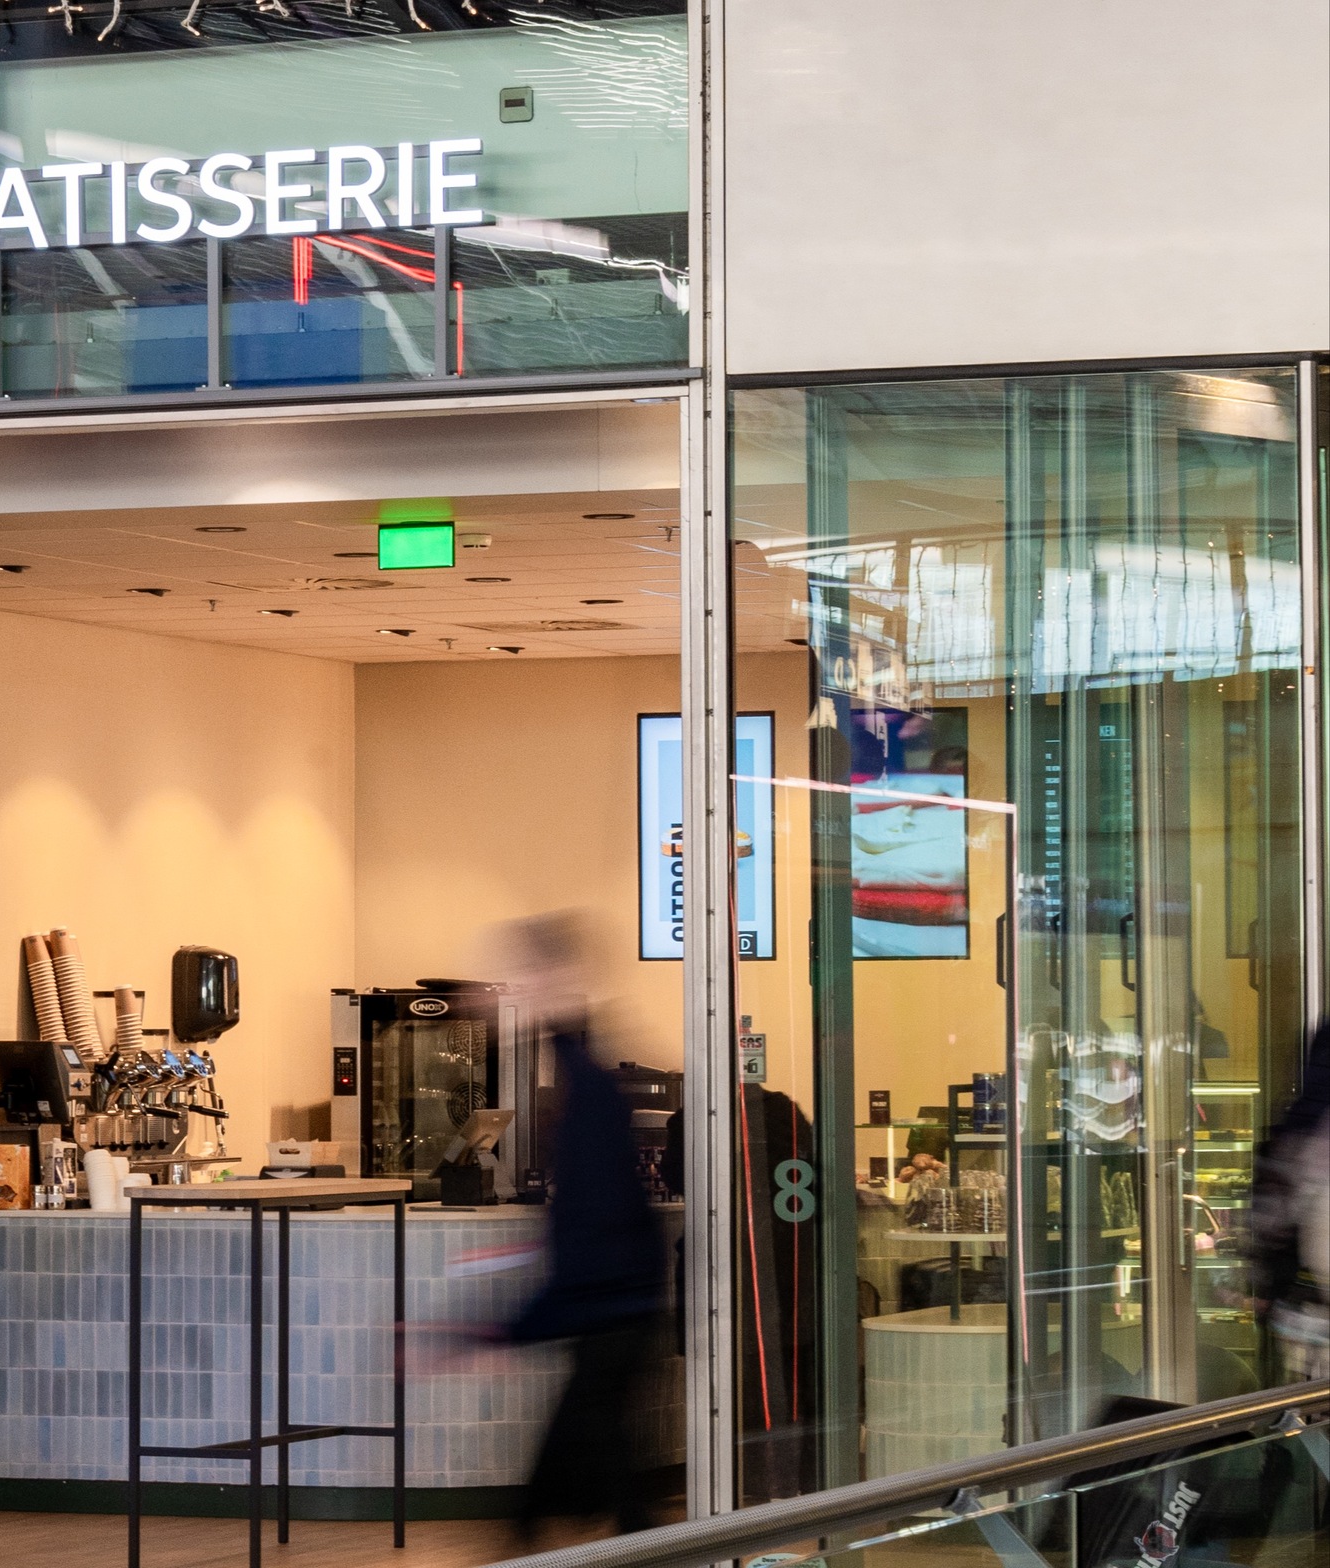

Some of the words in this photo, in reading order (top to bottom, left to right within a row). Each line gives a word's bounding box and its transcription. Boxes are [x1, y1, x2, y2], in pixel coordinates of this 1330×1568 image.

[741, 938, 751, 950] D
[739, 1037, 762, 1048] EAS
[773, 1159, 816, 1222] 8
[1163, 1480, 1202, 1530] JUST
